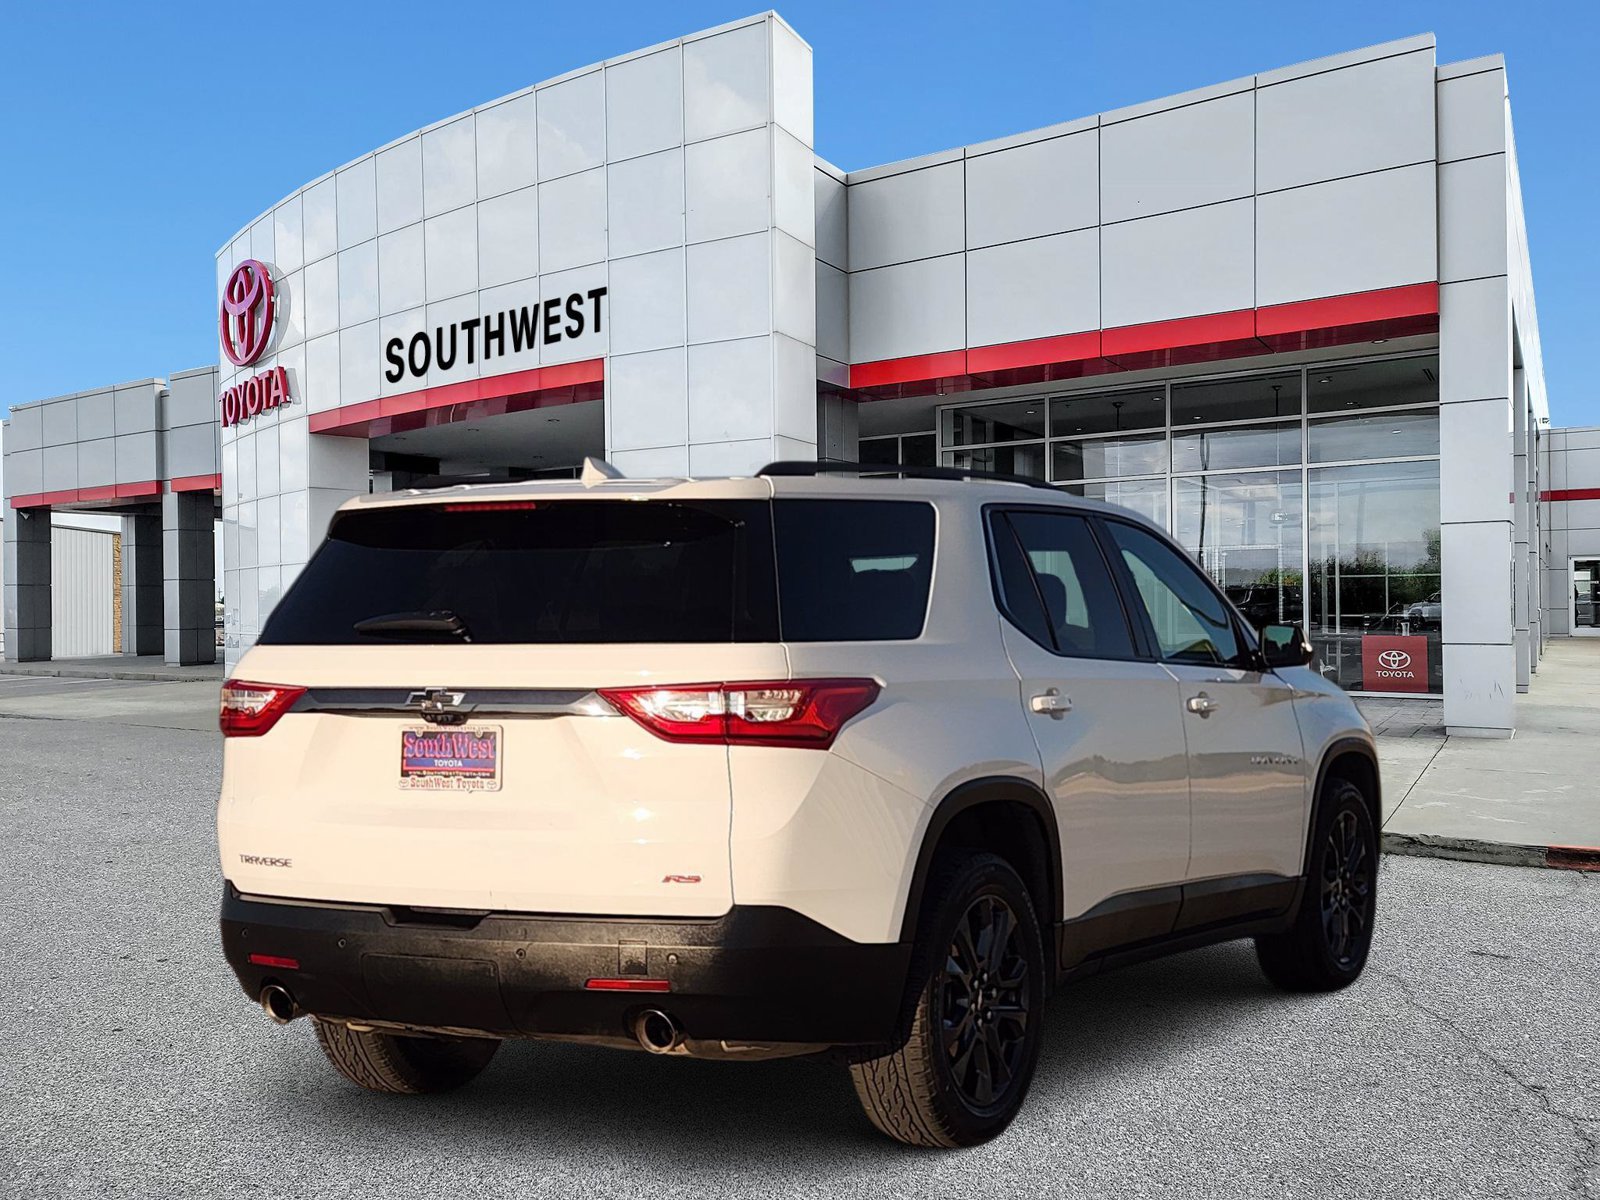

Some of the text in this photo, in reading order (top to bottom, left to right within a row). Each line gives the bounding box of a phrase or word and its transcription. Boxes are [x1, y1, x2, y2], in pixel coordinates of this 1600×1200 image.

[385, 286, 608, 383] SOUTHWEST
[219, 366, 291, 427] TOYOTA
[1376, 670, 1414, 678] TOYOTA
[404, 733, 496, 759] SouthWest
[434, 759, 463, 767] TOYOTA
[239, 854, 292, 868] TRAVERSE
